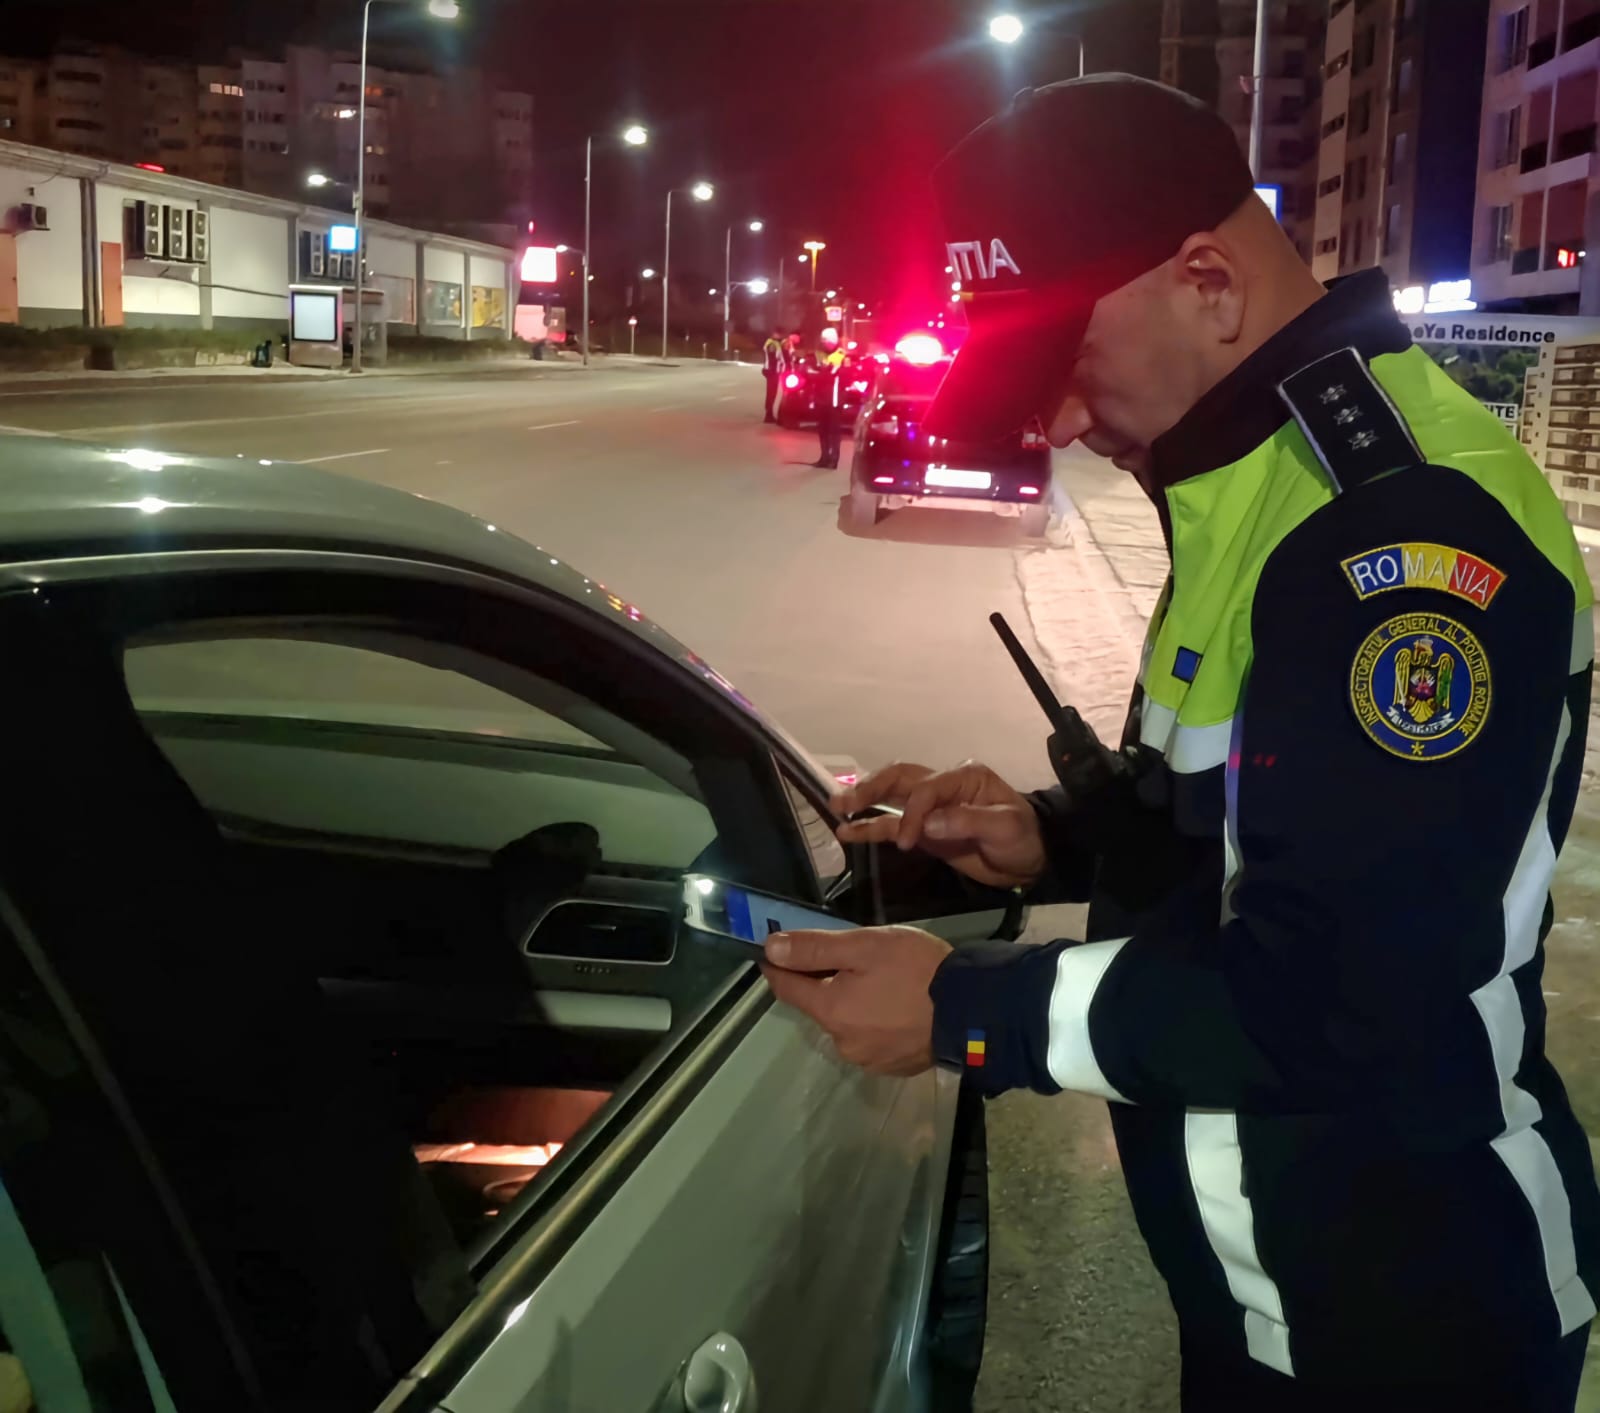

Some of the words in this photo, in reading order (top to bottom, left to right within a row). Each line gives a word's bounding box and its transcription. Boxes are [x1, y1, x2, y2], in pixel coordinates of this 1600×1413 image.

[1452, 324, 1555, 343] Residence
[1352, 551, 1490, 602] ROMANIA
[1355, 634, 1388, 726] INSPECTORATUL
[1388, 618, 1440, 636] GENERAL
[1443, 624, 1458, 641] AL
